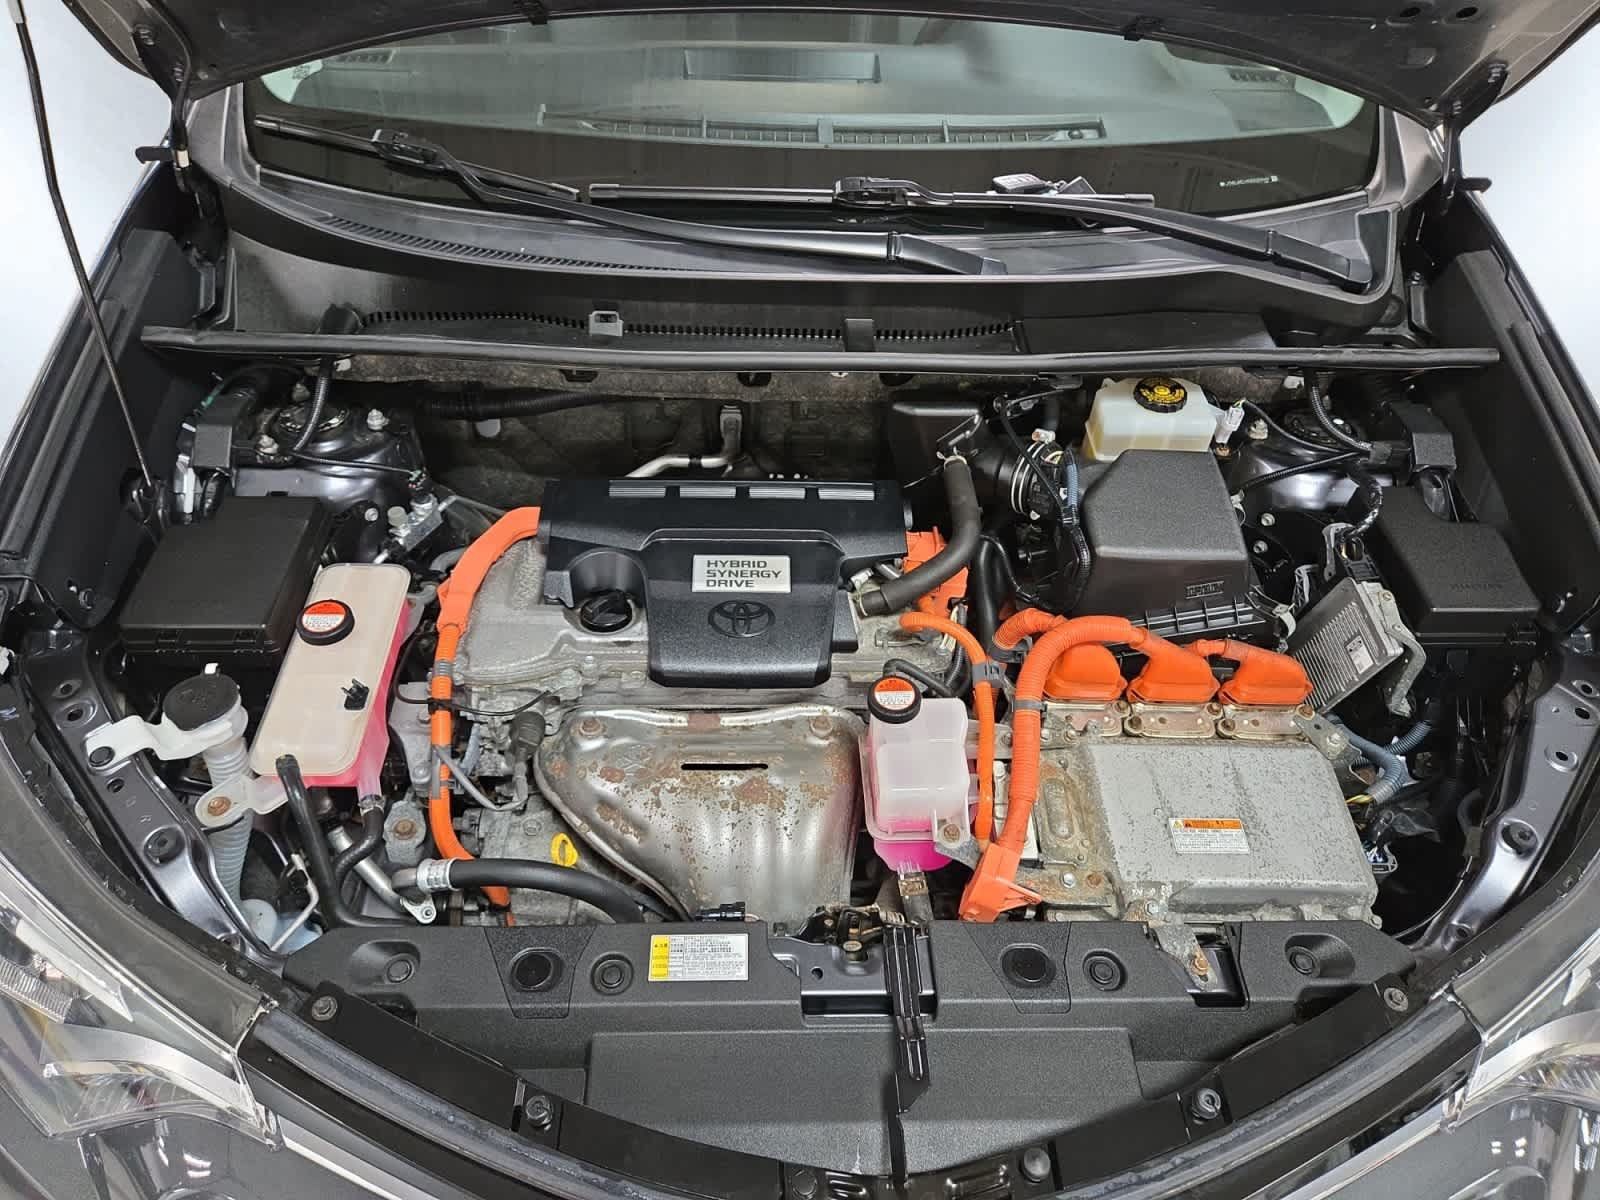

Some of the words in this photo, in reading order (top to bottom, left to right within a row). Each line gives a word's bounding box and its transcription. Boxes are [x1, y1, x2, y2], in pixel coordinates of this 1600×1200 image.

[707, 560, 768, 568] HYBRID
[706, 569, 783, 578] SYNERGY
[706, 579, 755, 588] DRIVE
